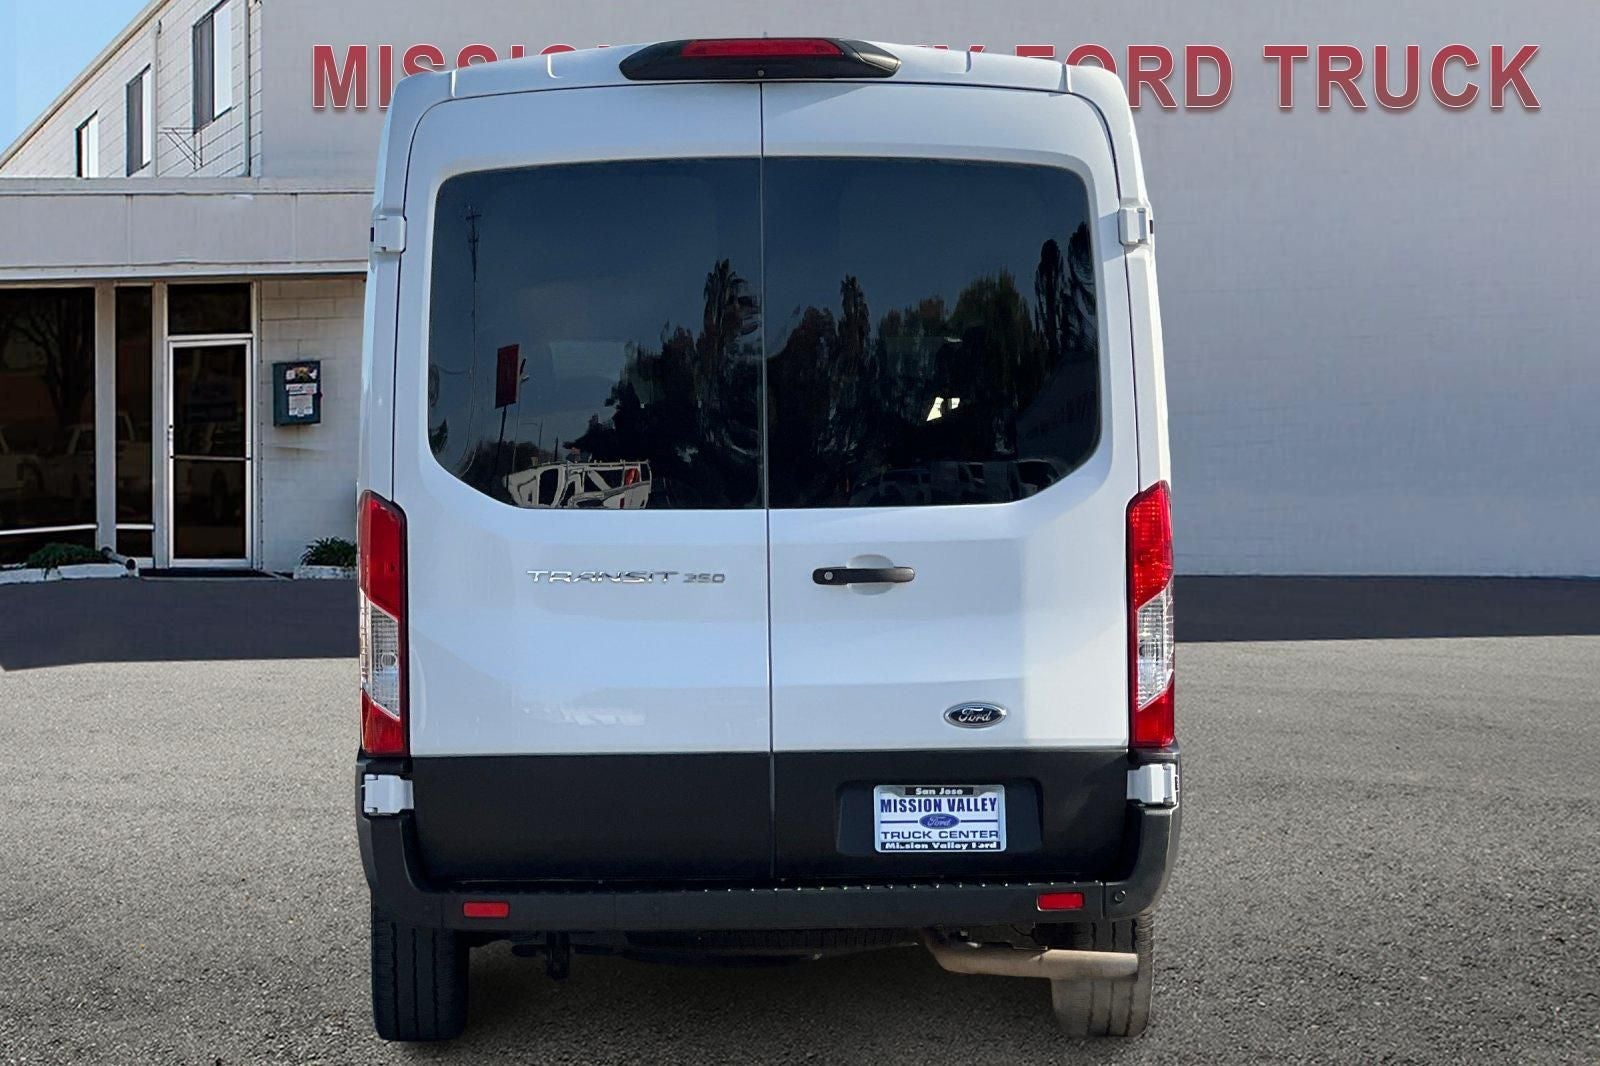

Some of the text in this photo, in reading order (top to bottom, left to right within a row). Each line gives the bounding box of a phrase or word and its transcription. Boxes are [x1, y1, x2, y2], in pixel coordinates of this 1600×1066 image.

[1014, 43, 1542, 110] RD TRUCK
[527, 570, 726, 584] TRANSIT 350
[958, 708, 992, 722] Ford
[916, 787, 964, 796] San Jose
[880, 798, 997, 812] MISSION VALLEY
[927, 816, 951, 827] Ford
[881, 830, 998, 839] TRUCK CENTER
[932, 841, 968, 850] Valley
